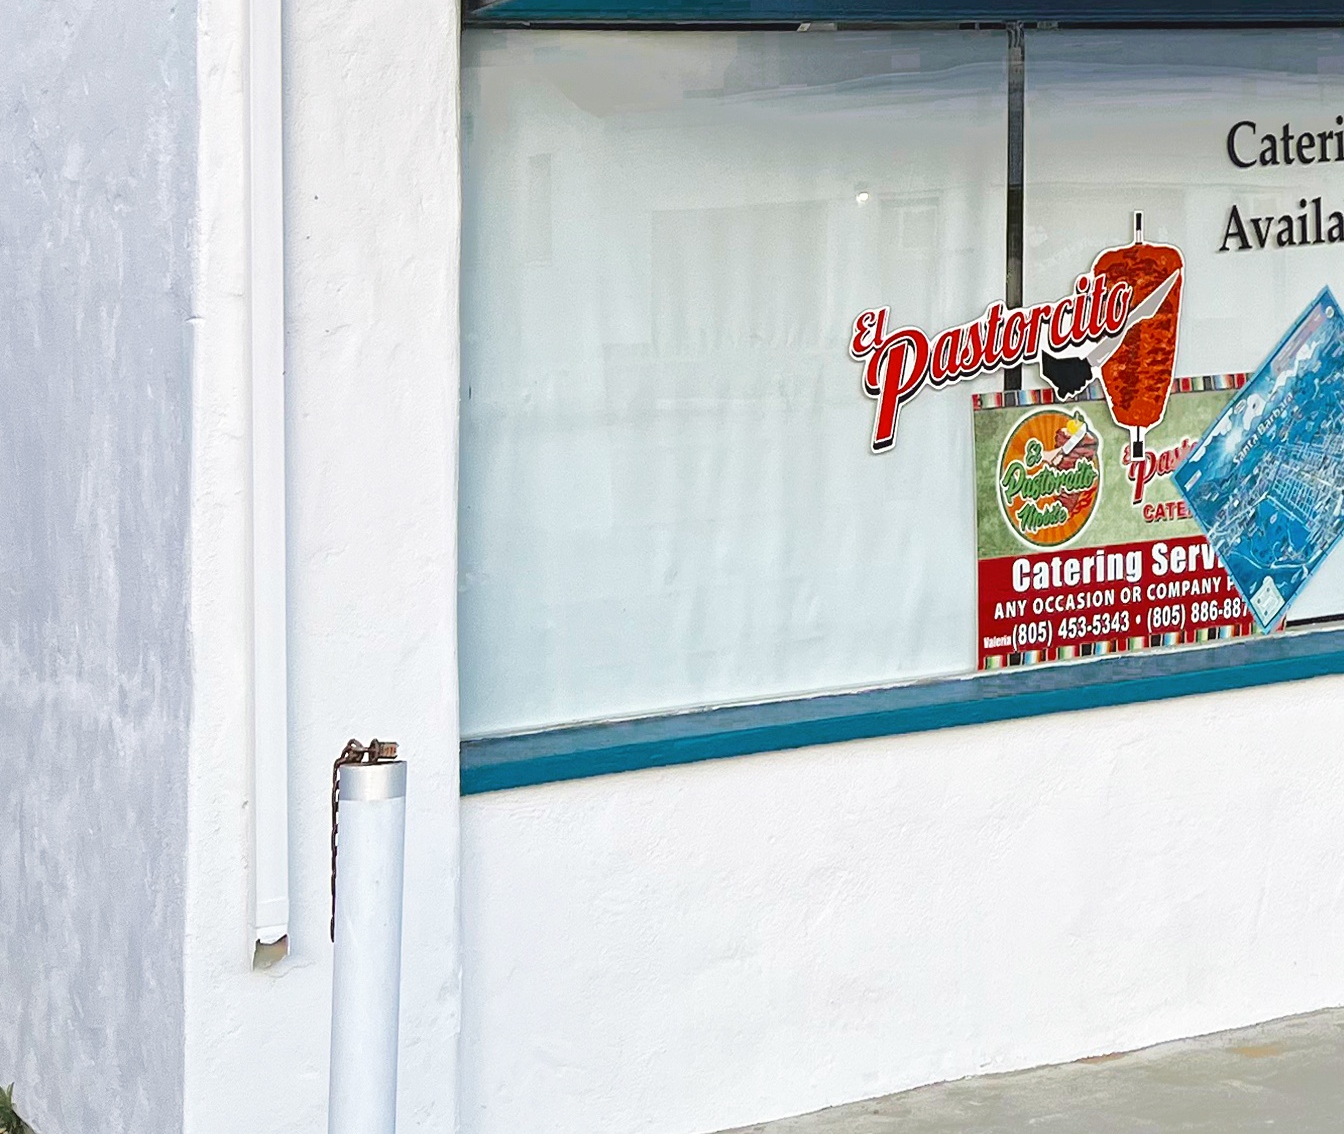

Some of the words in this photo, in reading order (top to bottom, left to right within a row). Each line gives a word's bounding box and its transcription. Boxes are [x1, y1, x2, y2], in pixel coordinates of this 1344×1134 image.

[851, 306, 889, 357] El
[864, 273, 1135, 451] Pastorcito
[1232, 433, 1259, 466] Santa
[1257, 392, 1294, 436] Barbara
[1024, 439, 1044, 467] El
[1001, 459, 1097, 503] Pastorcito
[1016, 501, 1068, 533] Mobile
[1143, 499, 1194, 524] CATE
[1012, 548, 1143, 593] Catering
[994, 599, 1027, 620] ANY
[1032, 589, 1115, 615] OCCASION
[1120, 585, 1142, 604] OR
[1146, 576, 1221, 601] COMPANY
[983, 634, 1012, 649] Valeria
[1012, 620, 1053, 652] (805)
[1058, 610, 1130, 640] 453-5343
[1147, 604, 1187, 634] (805)
